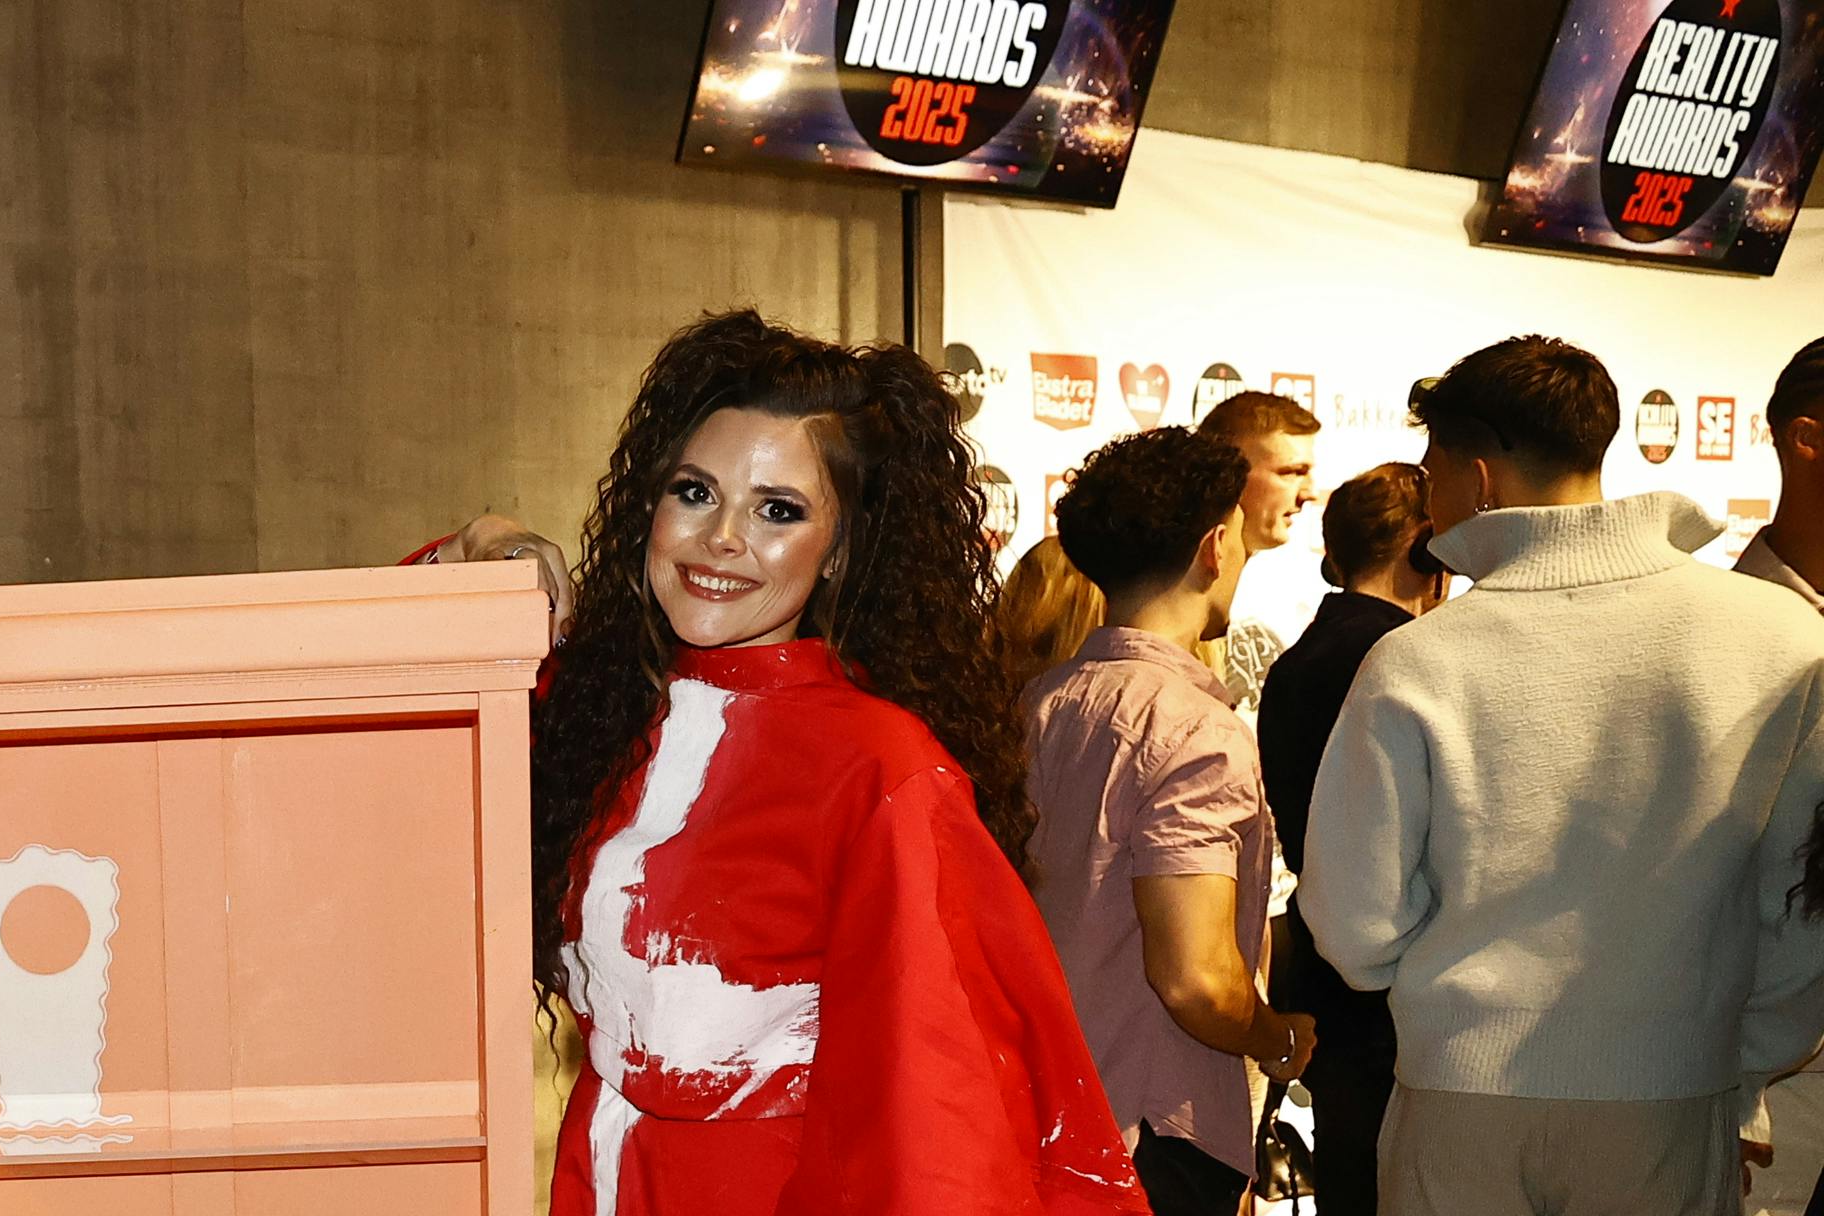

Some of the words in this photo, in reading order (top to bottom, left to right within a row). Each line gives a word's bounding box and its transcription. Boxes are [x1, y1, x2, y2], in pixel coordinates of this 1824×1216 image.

[845, 0, 1047, 88] AWARDS
[1635, 18, 1778, 107] REALITY
[880, 77, 976, 147] 2025
[1607, 93, 1750, 178] AWARDS
[1621, 172, 1694, 227] 2025
[1699, 401, 1732, 444] SE
